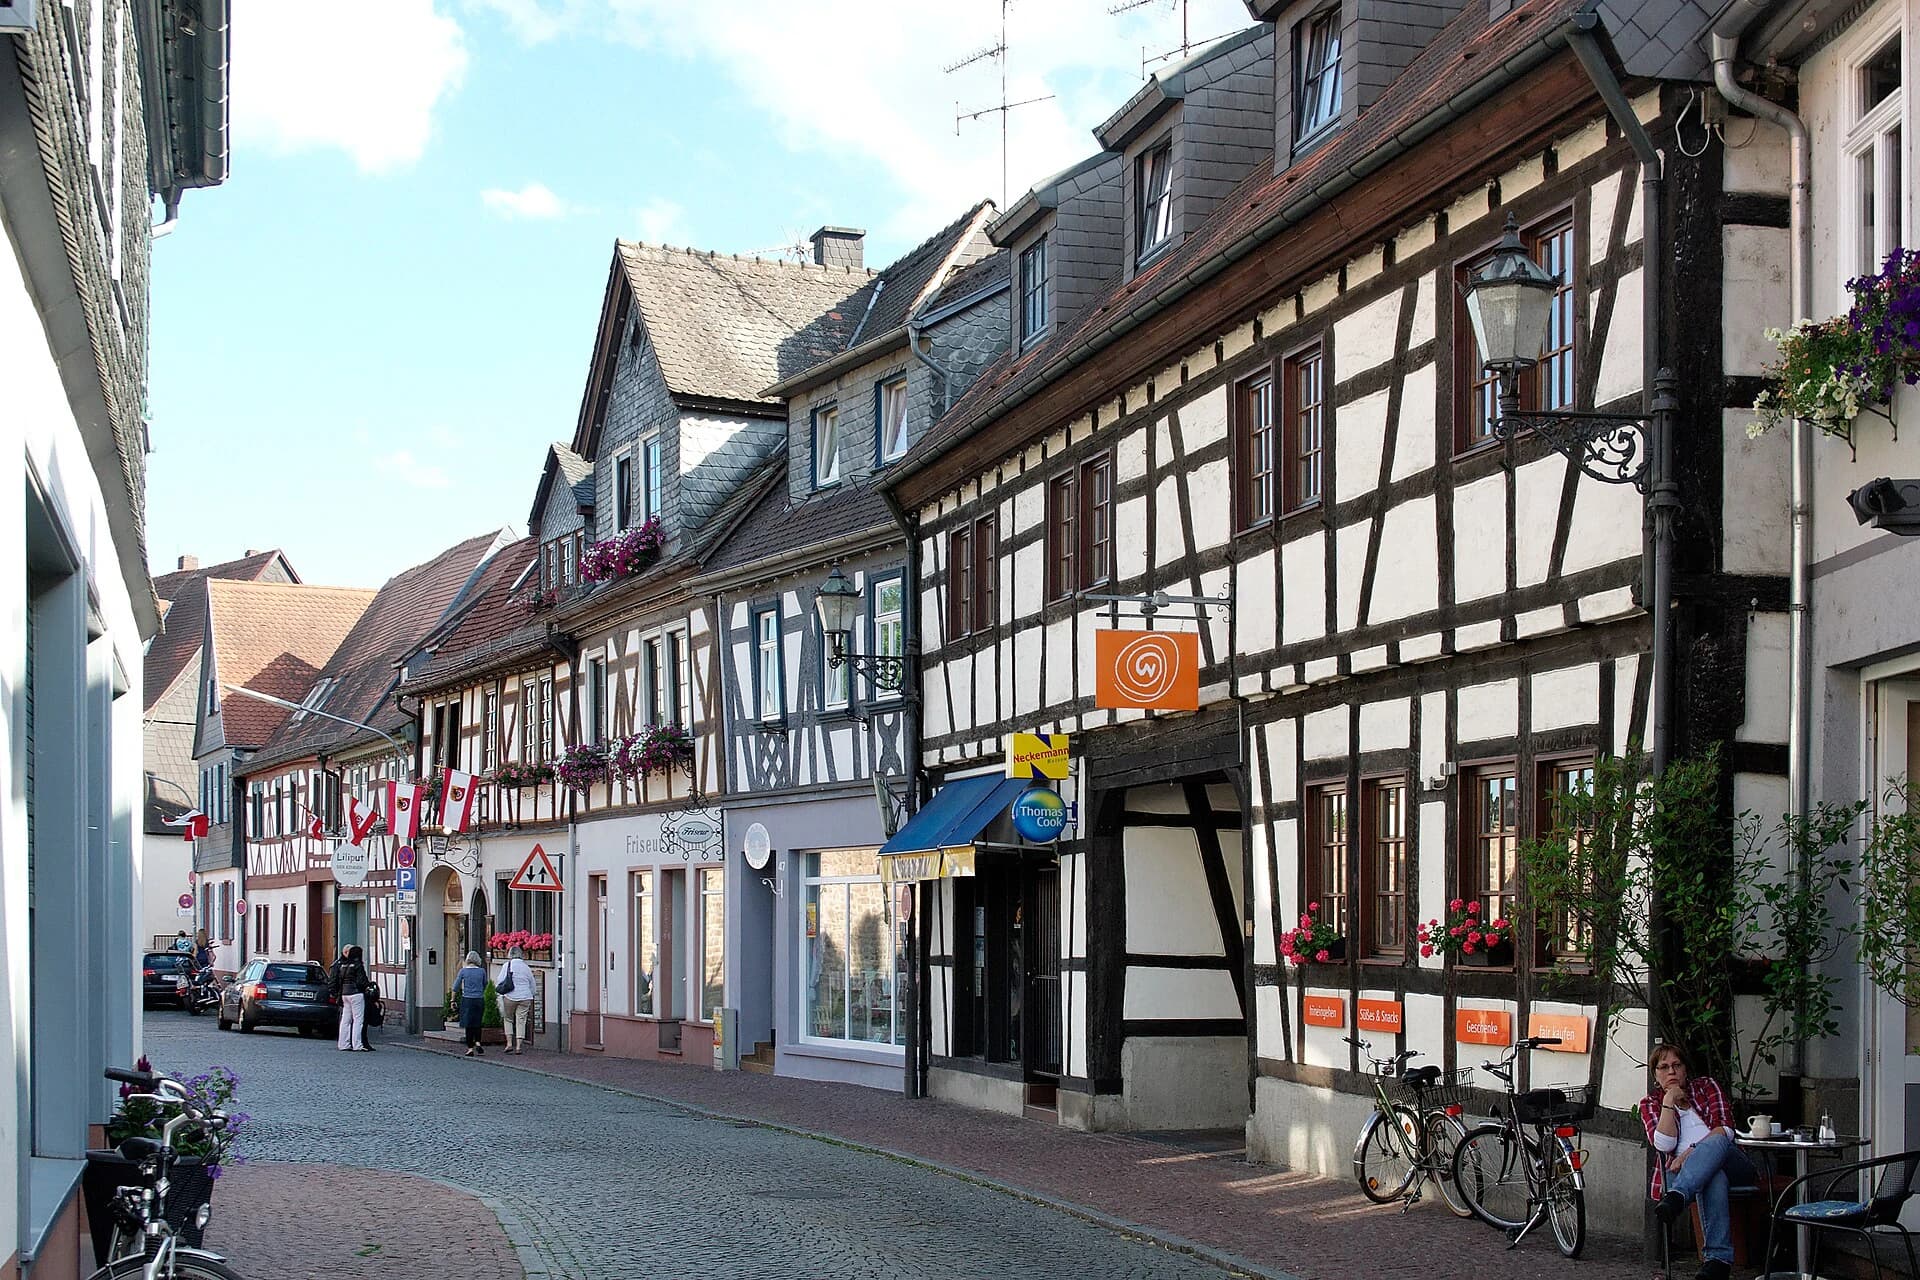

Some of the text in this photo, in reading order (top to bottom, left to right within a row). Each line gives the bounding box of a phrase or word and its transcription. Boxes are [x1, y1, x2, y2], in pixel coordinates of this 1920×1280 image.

[1013, 747, 1070, 764] Neckermann
[1020, 806, 1064, 818] Thomas
[1036, 816, 1063, 828] Cook
[681, 827, 709, 837] Friseur
[337, 853, 364, 864] Liliput
[400, 870, 412, 888] P
[1359, 1008, 1399, 1024] Süßes & Snacks
[1466, 1020, 1498, 1035] Geschenke
[1552, 1026, 1575, 1040] kaufen
